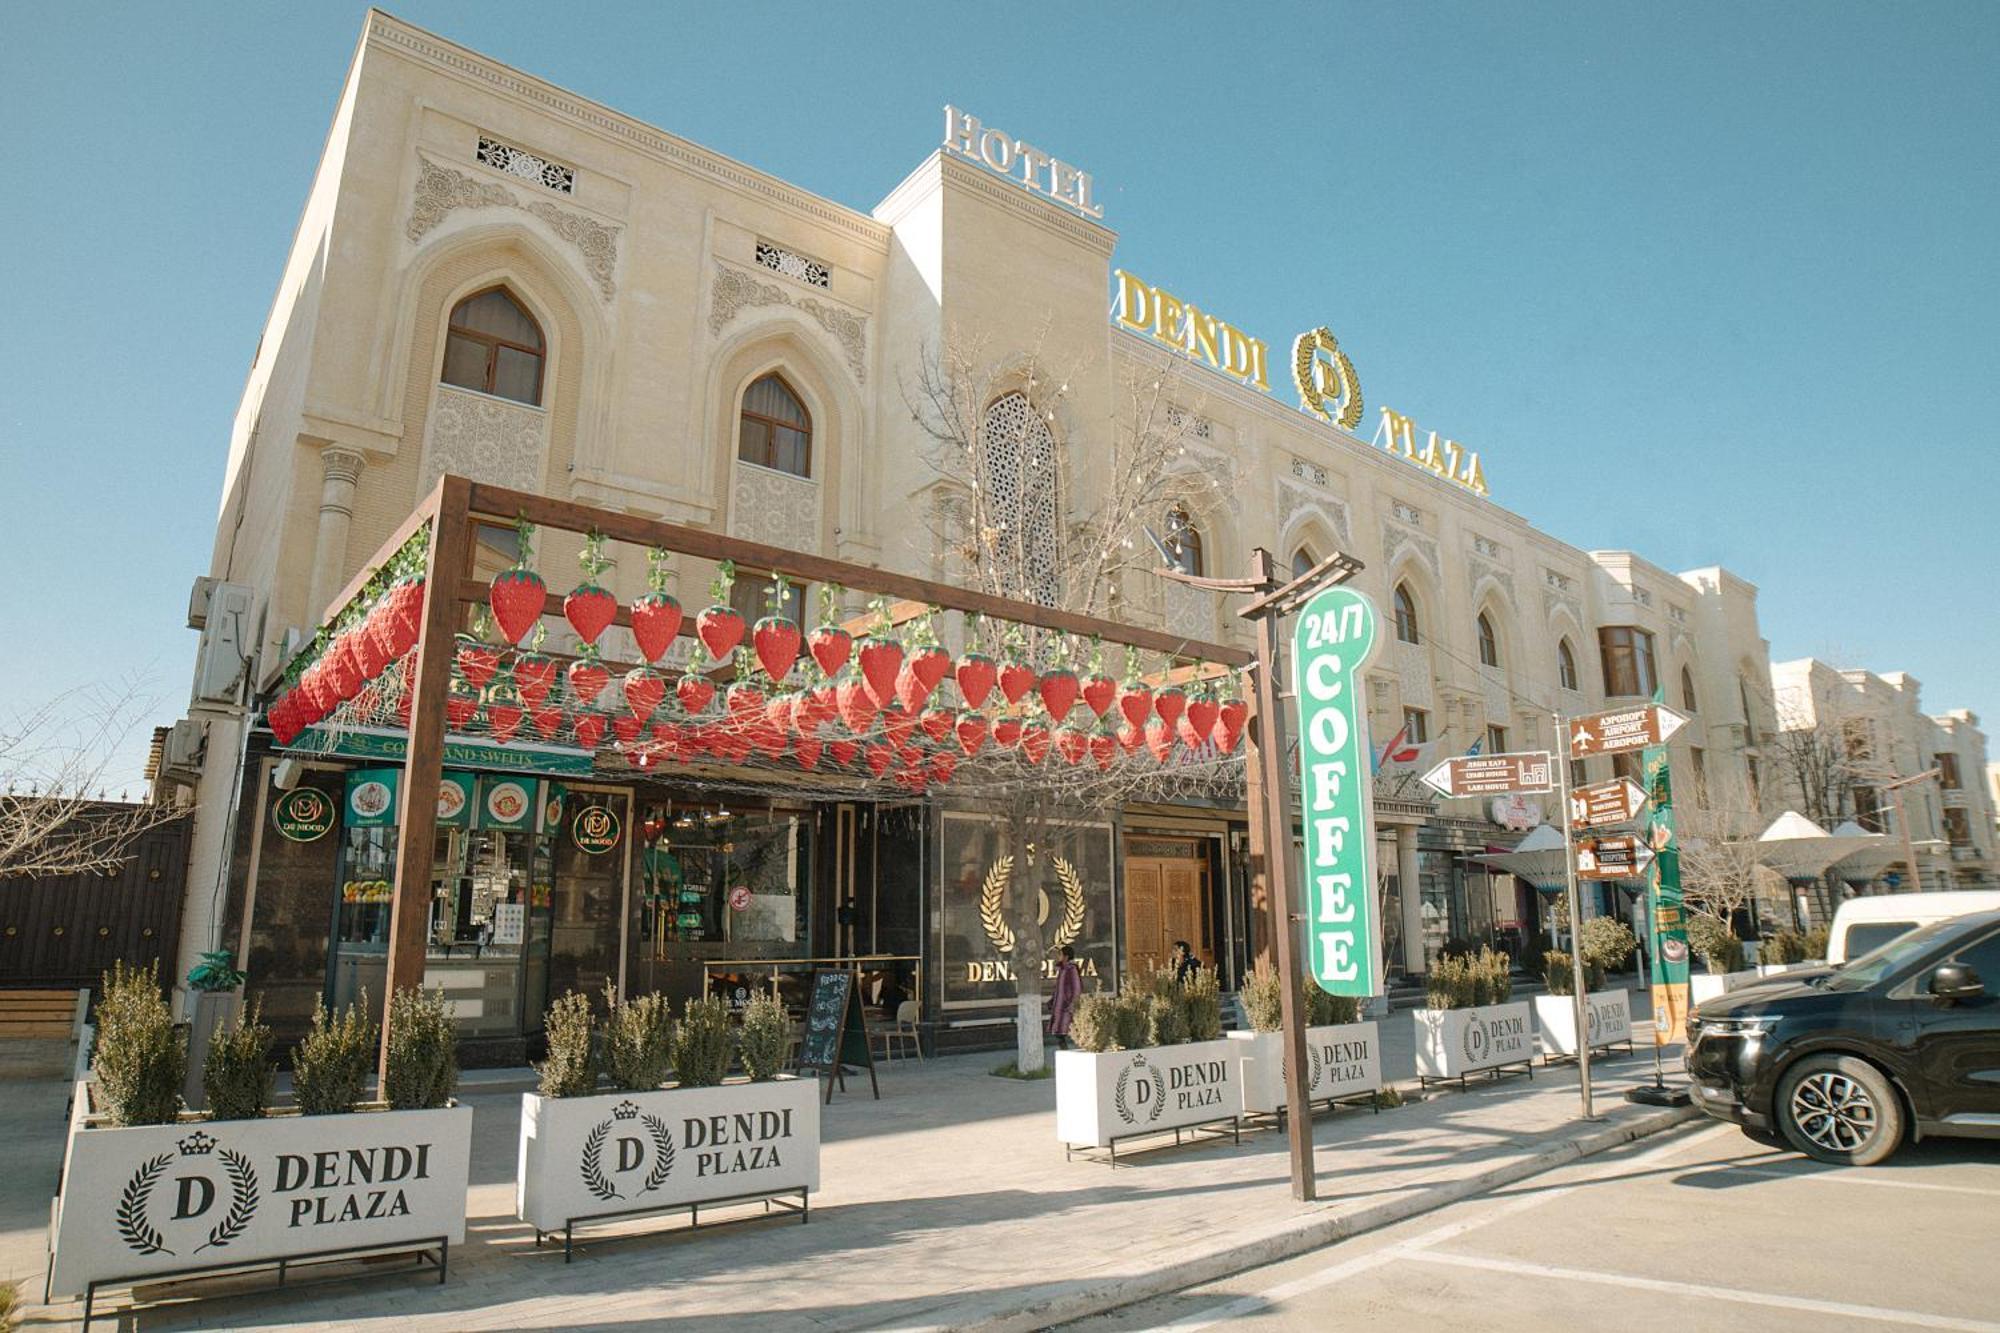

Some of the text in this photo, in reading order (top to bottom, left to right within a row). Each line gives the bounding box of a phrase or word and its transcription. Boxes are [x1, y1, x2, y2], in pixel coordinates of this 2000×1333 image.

[943, 104, 1104, 218] HOTEL
[1114, 268, 1271, 391] DENDI
[1381, 405, 1490, 496] PLAZA
[1305, 603, 1364, 650] 24/7
[1600, 710, 1648, 726] АЭРОПОРТ
[1604, 722, 1643, 737] AIRPORT
[444, 747, 533, 765] AND SWEETS
[1603, 734, 1651, 750] AEROPORT
[1306, 654, 1358, 982] COFFEE
[967, 957, 1098, 982] DEN PLZA
[1490, 1016, 1524, 1037] DENDI
[1323, 1040, 1368, 1065] DENDI
[1495, 1037, 1522, 1052] PLAZA
[1169, 1060, 1227, 1090] DENDI
[1330, 1064, 1365, 1083] PLAZA
[1136, 1079, 1151, 1104] D
[1178, 1087, 1223, 1110] PLAZA
[682, 1109, 793, 1150] DENDI
[272, 1143, 433, 1193] DENDI
[616, 1137, 645, 1173] D
[696, 1145, 782, 1177] PLAZA
[170, 1175, 216, 1221] D
[288, 1189, 413, 1228] PLAZA
